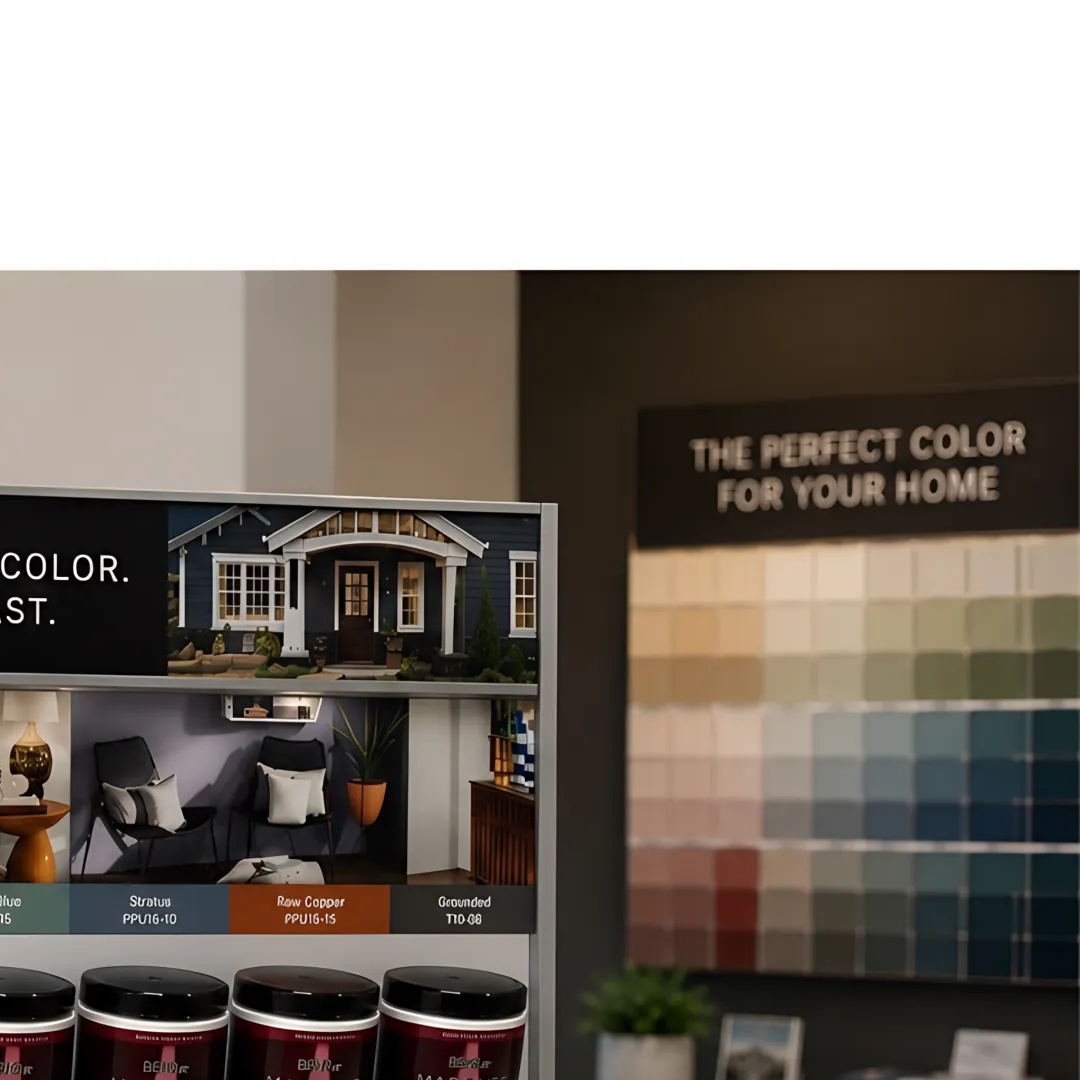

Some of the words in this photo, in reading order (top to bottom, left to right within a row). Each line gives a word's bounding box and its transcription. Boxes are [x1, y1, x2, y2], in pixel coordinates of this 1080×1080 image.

[689, 435, 754, 472] THE
[760, 428, 903, 469] PERFECT
[910, 421, 1027, 460] COLOR
[717, 477, 784, 513] FOR
[791, 471, 886, 510] YOUR
[895, 465, 1000, 506] HOME
[0, 552, 129, 583] COLOR.
